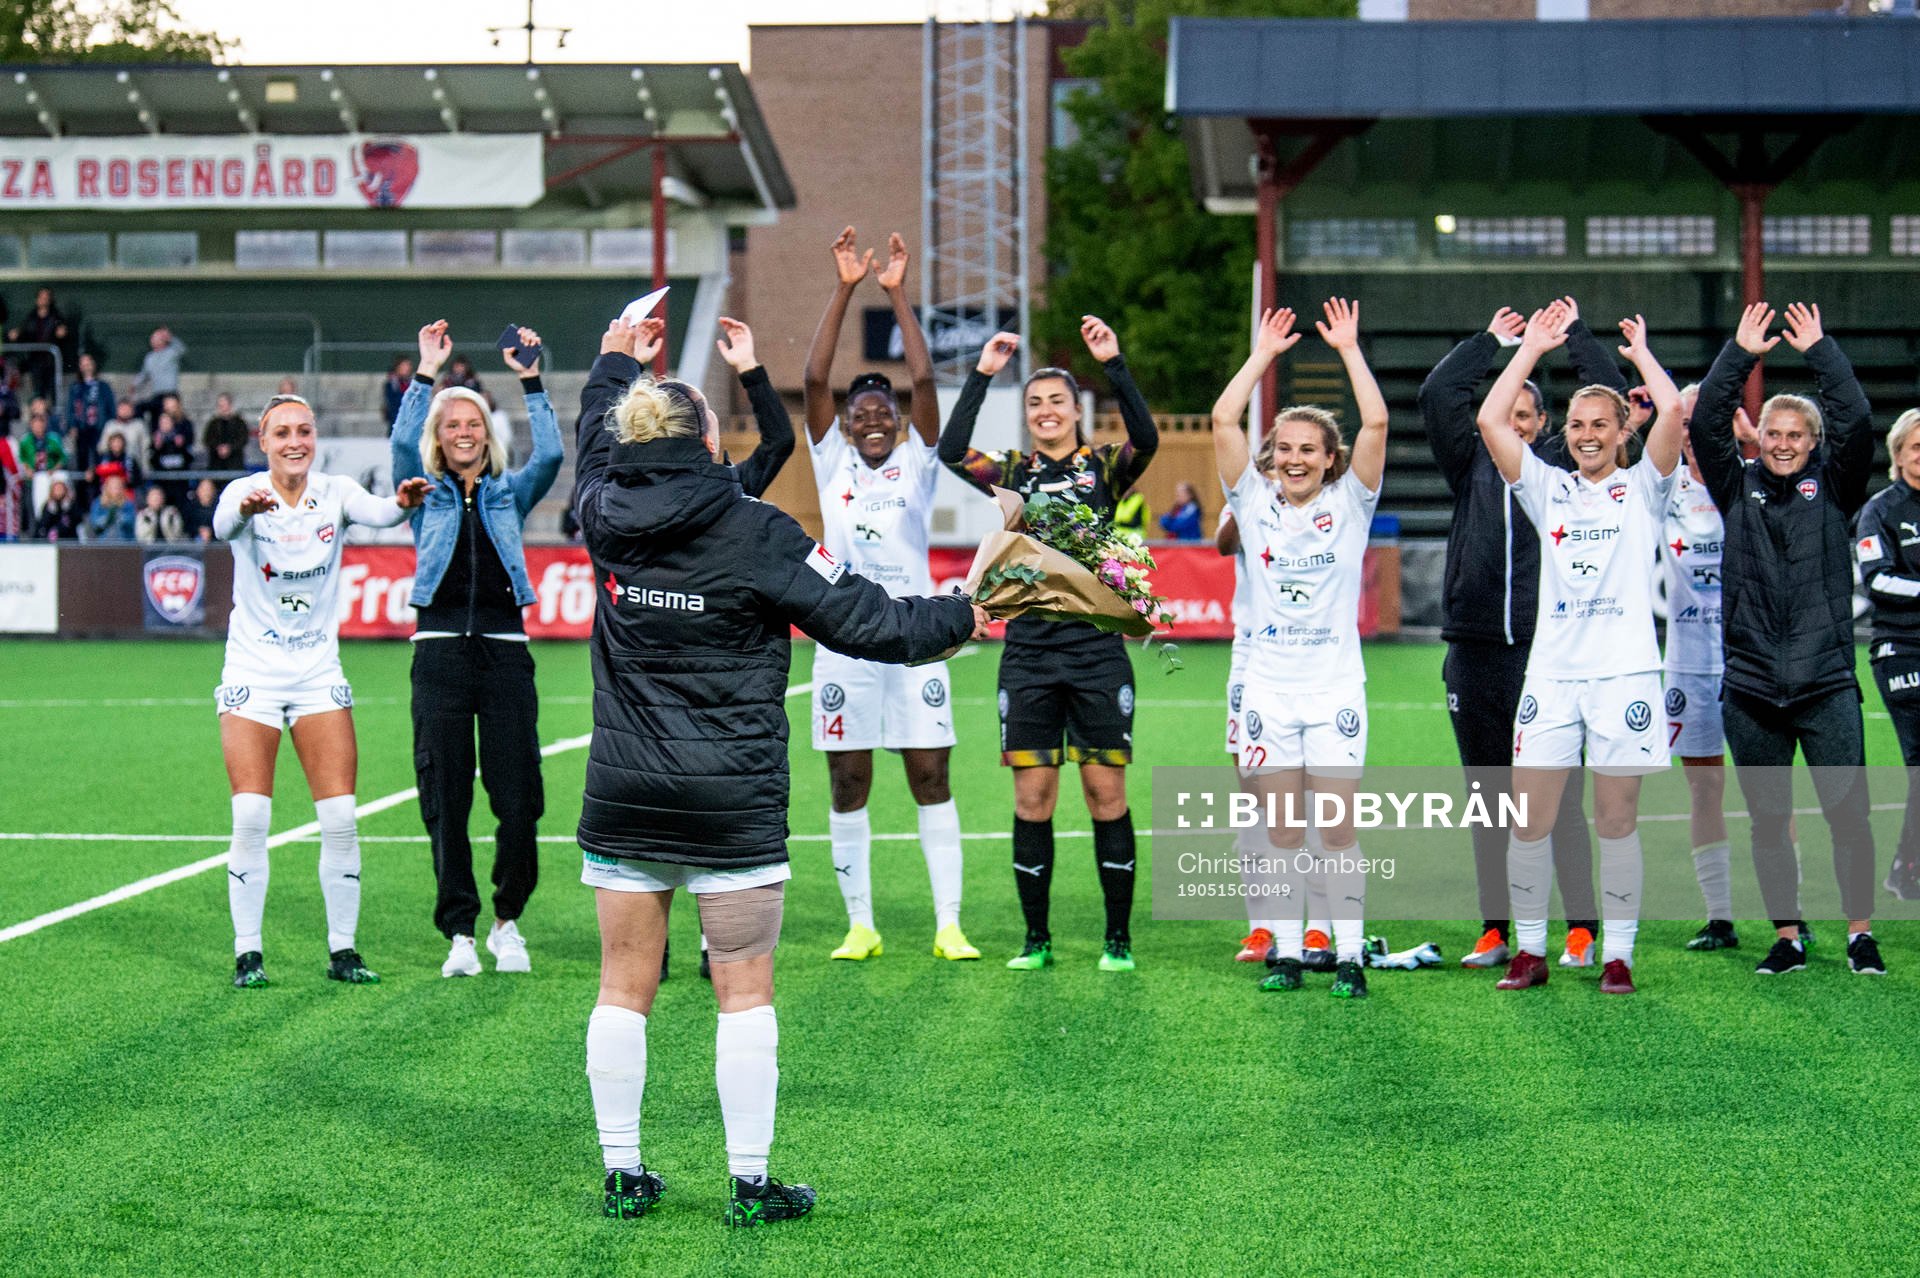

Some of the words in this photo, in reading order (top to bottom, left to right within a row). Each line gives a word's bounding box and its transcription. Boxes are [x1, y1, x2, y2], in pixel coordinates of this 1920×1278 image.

[77, 143, 337, 198] ROSENGÅRD
[821, 714, 844, 741] 14
[1228, 719, 1239, 744] 2
